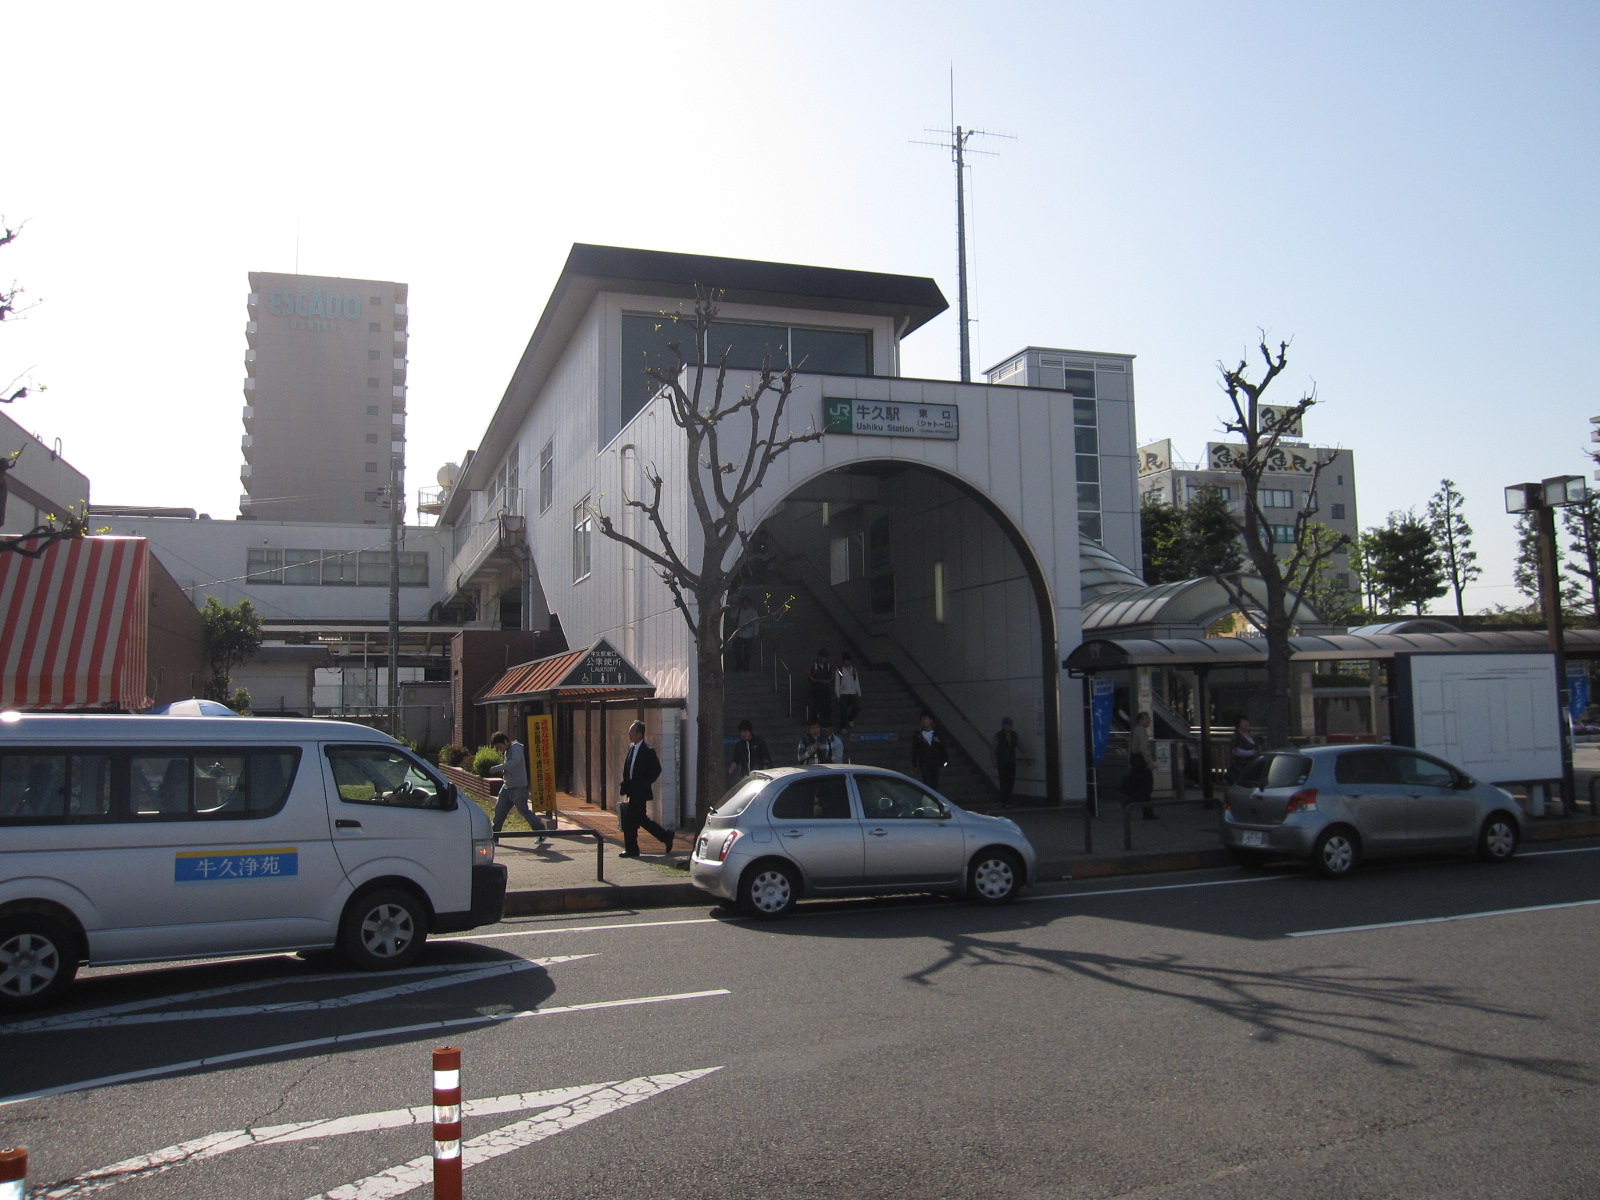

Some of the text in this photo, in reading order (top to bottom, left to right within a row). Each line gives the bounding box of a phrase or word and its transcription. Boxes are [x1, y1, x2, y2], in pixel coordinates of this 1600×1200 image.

[268, 281, 362, 320] ESCADO
[829, 403, 851, 417] JR
[856, 404, 952, 422] 牛久駅 東口
[856, 422, 884, 432] Ushiku
[887, 424, 915, 433] Station
[586, 657, 621, 667] 公衆便所
[195, 855, 281, 879] 牛久浄苑
